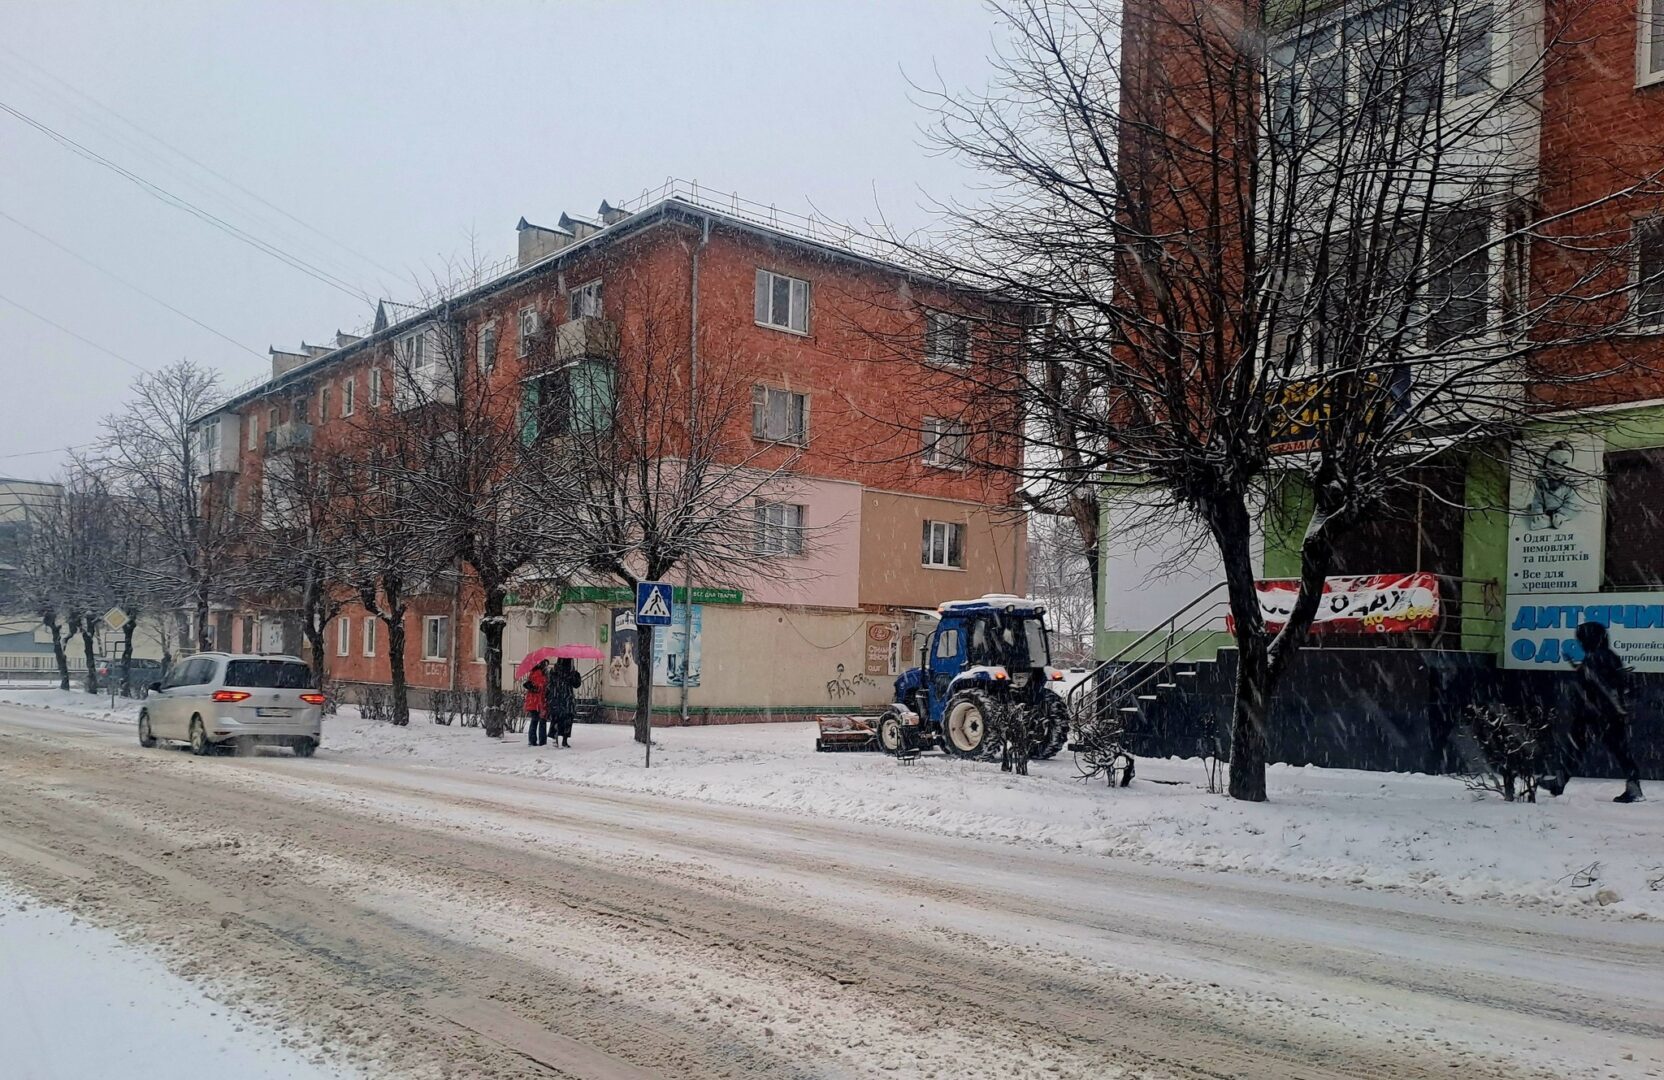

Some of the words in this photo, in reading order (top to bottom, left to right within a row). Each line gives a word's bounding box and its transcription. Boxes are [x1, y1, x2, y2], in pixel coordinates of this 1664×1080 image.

[1523, 533, 1551, 544] Одяг
[1554, 533, 1574, 542] для
[1522, 544, 1577, 553] немовлят
[1522, 555, 1534, 563] та
[1537, 551, 1590, 563] підлітків
[1522, 569, 1541, 579] Все
[1544, 570, 1564, 579] для
[1522, 581, 1578, 592] хрещення
[1511, 605, 1664, 631] ДИТЯЧИ
[1511, 638, 1586, 663] ОДЯ
